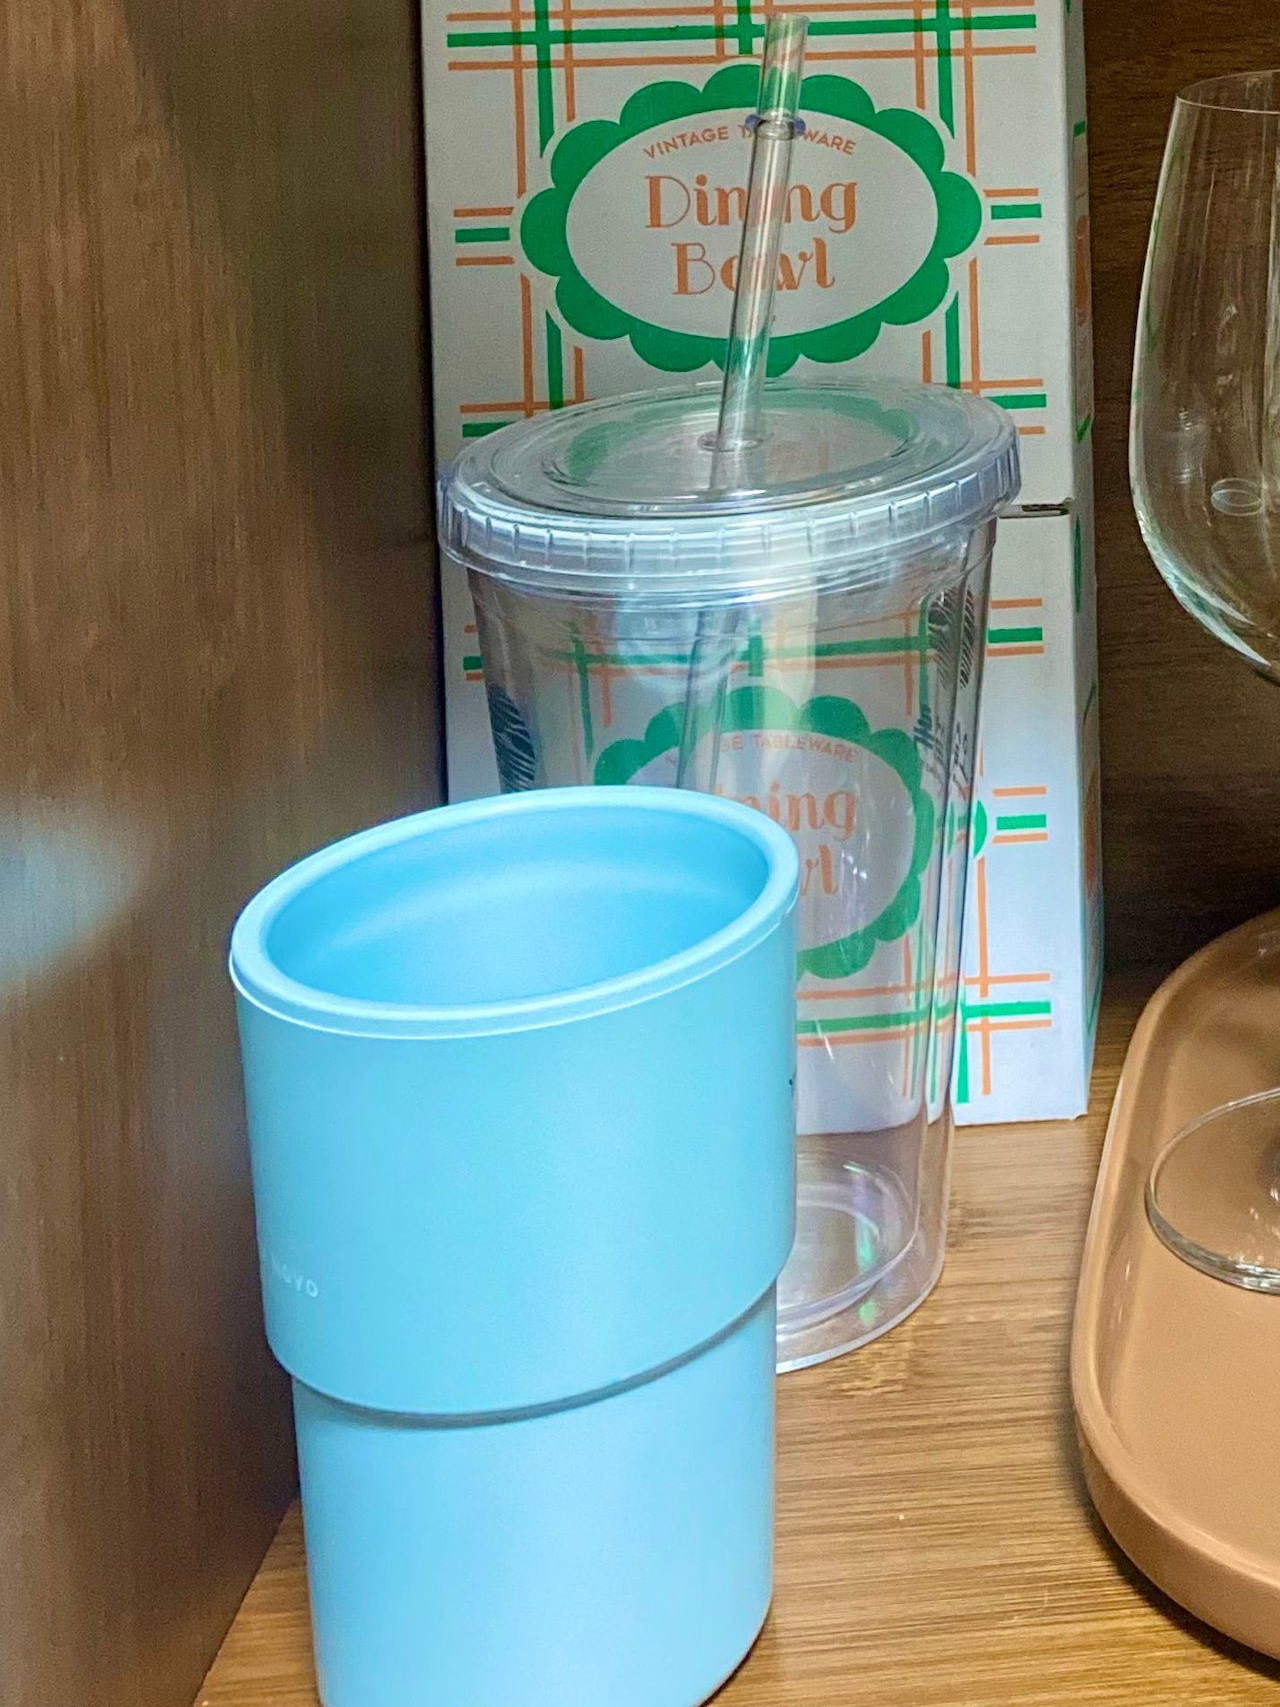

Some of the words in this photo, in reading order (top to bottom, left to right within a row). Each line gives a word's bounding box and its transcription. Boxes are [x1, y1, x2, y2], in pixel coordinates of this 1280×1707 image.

[642, 125, 729, 160] VINTAGE
[738, 124, 857, 156] TWARE
[644, 173, 858, 234] Dinng
